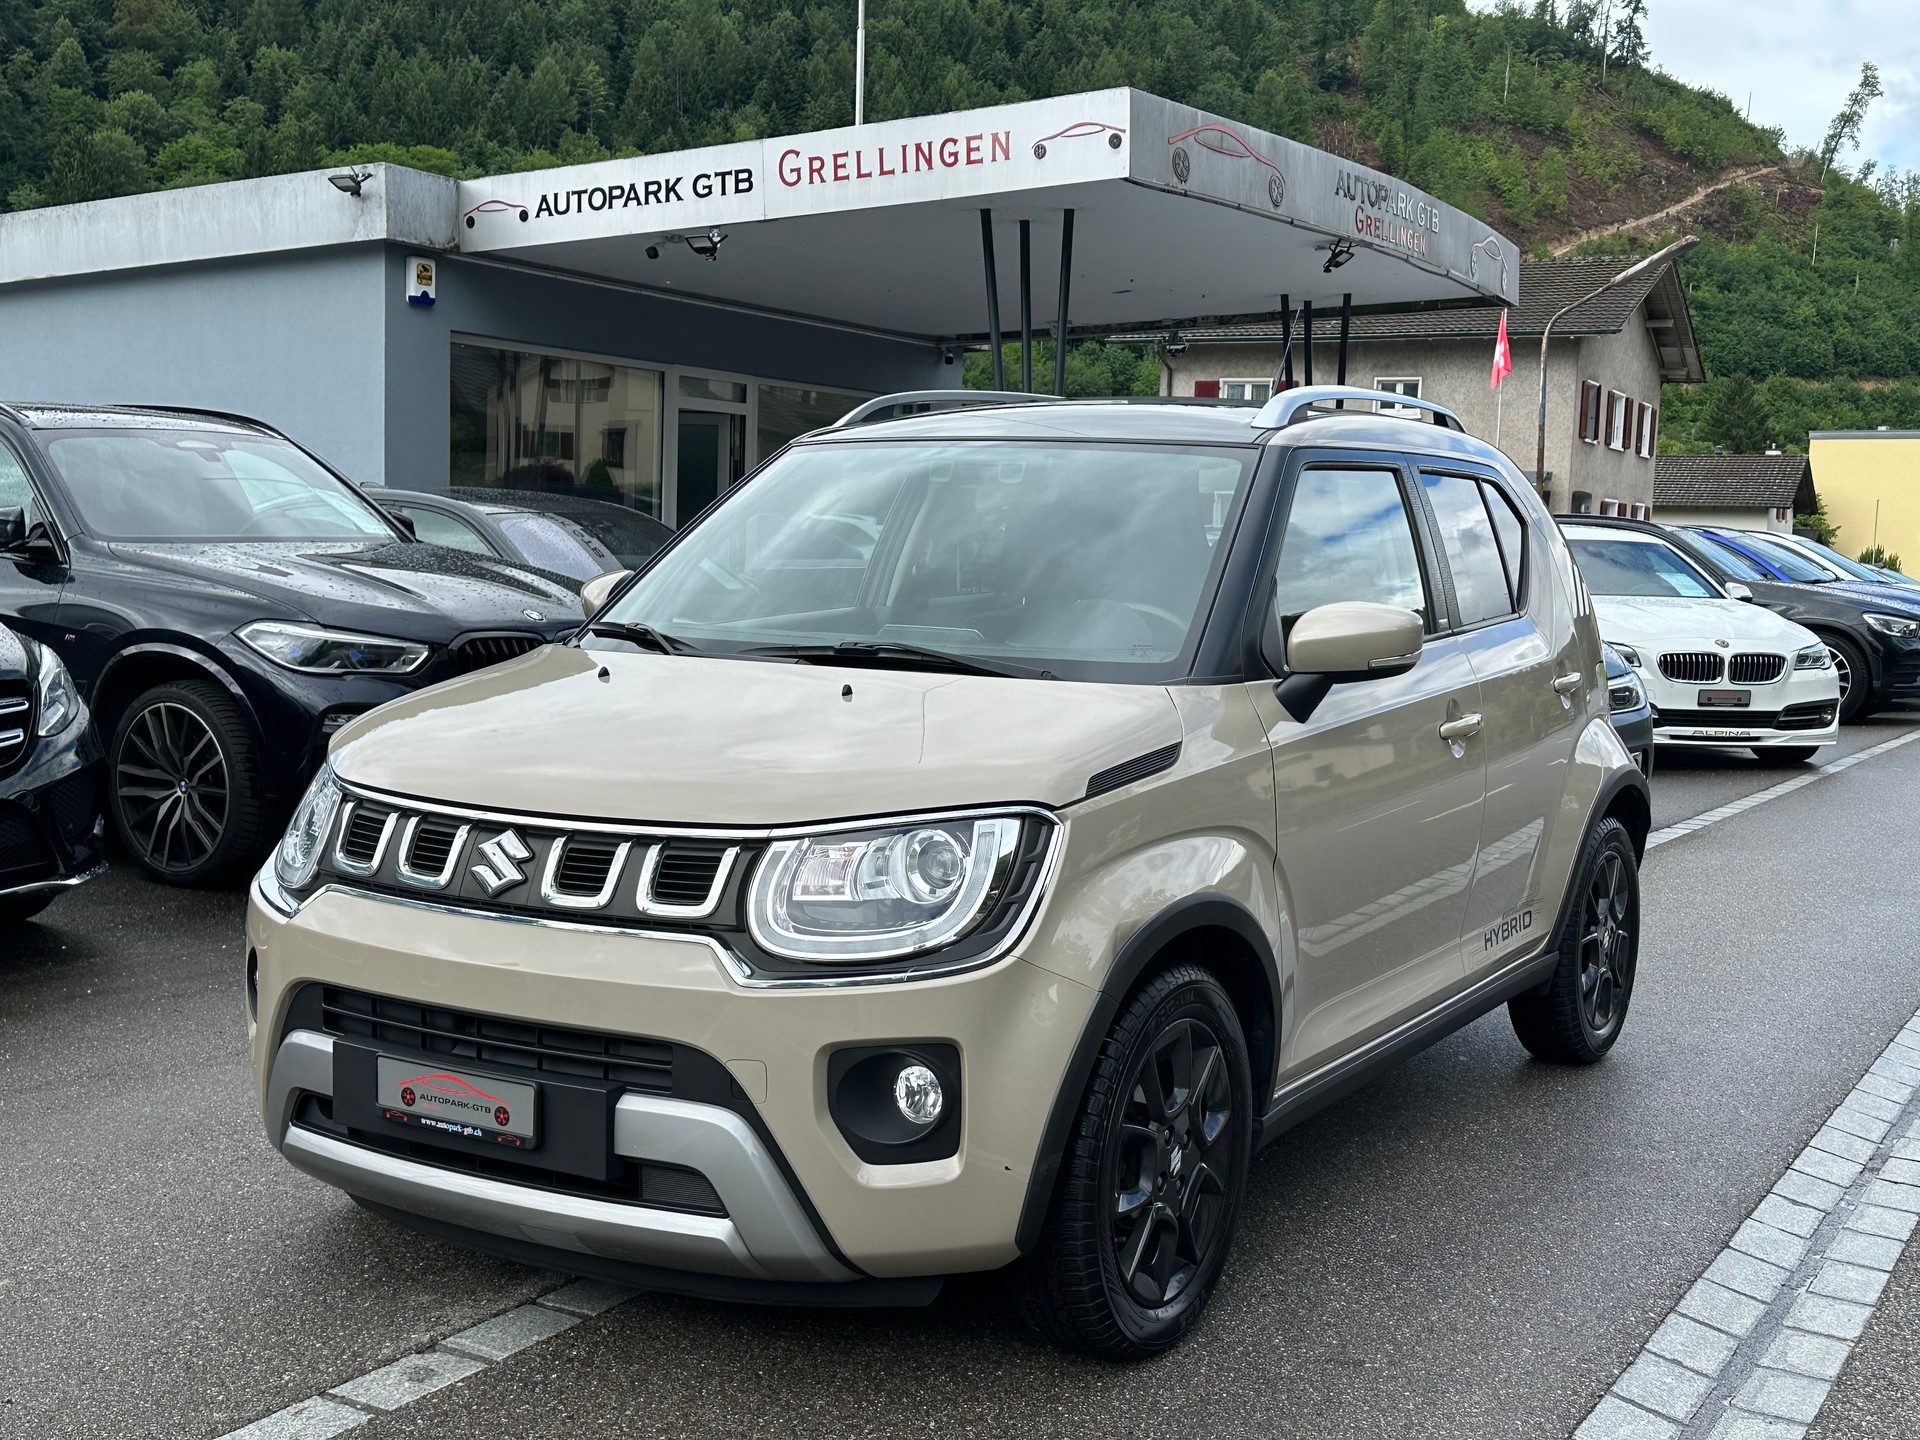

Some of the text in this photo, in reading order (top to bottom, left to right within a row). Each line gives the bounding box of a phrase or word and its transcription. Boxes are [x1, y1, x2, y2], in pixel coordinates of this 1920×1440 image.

[534, 131, 1011, 219] AUTOPARK GTB GRELLINGEN
[1334, 169, 1440, 233] AUTOPARK GTB
[1355, 206, 1425, 256] GRELLINGEN
[1484, 910, 1532, 951] HYBRID
[420, 1093, 491, 1114] AUTOPARK-GTB
[421, 1118, 482, 1136] www.autopark-gtb.ch
